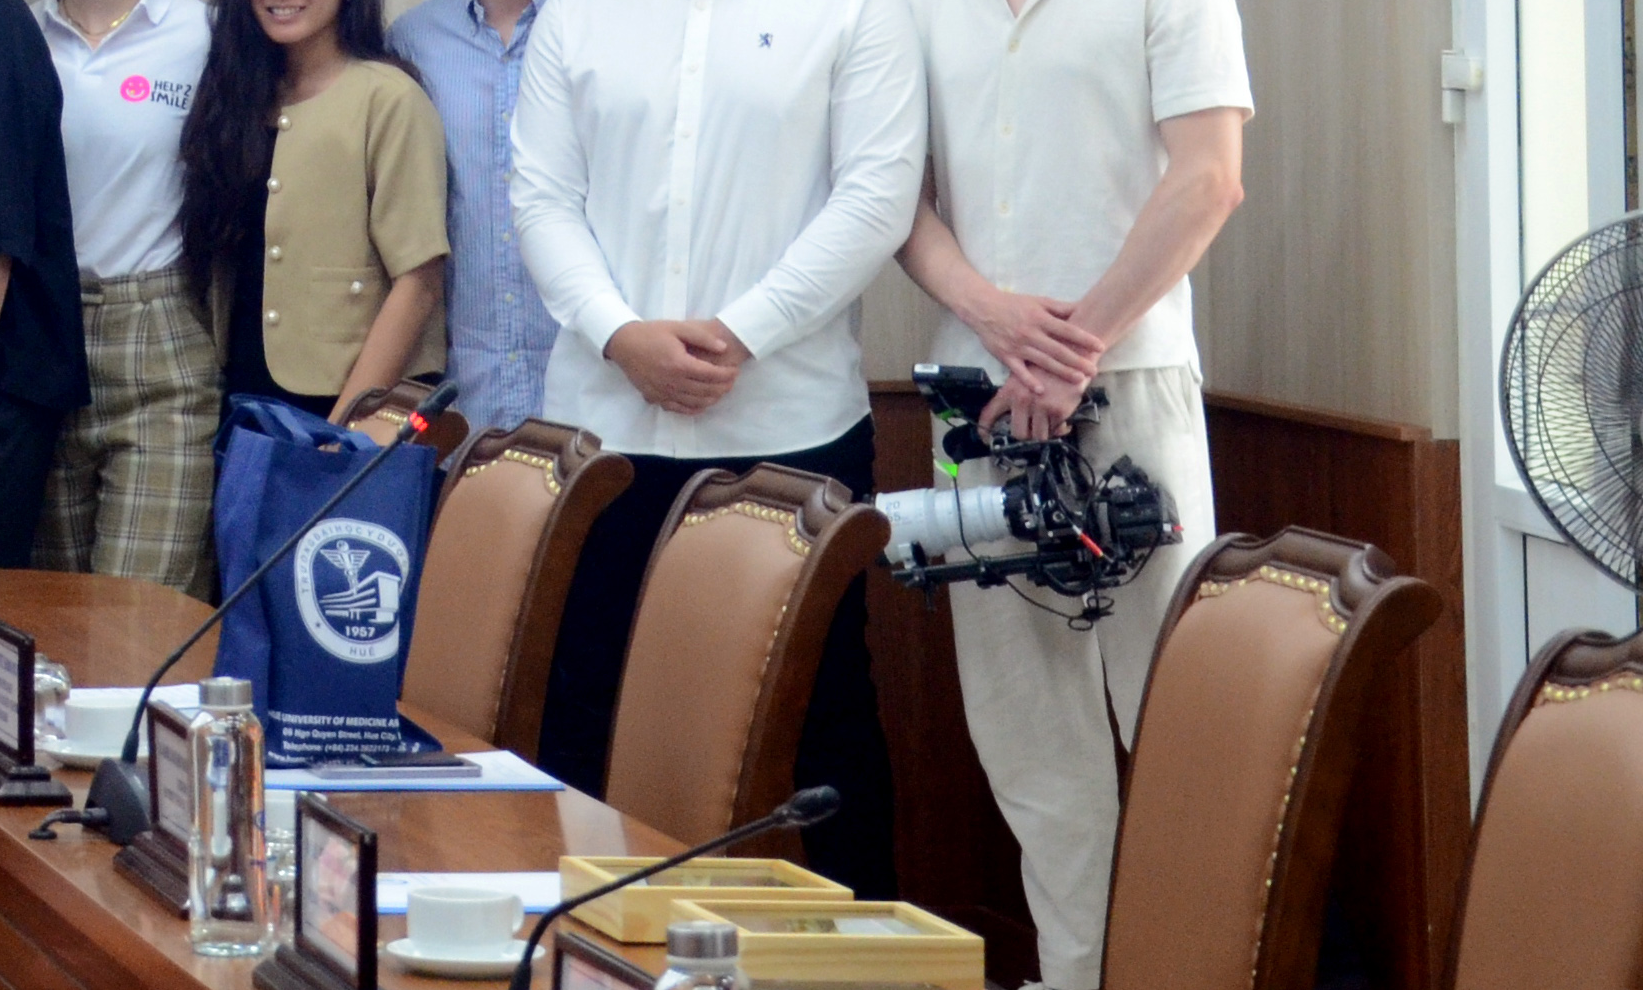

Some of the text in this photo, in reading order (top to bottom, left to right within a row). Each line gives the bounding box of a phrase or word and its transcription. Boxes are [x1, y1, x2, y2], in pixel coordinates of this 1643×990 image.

[153, 80, 193, 97] HELP 2
[345, 626, 376, 638] 1957
[281, 713, 332, 724] UNIVERSITY
[333, 716, 344, 726] OF
[346, 717, 387, 727] MEDICINE
